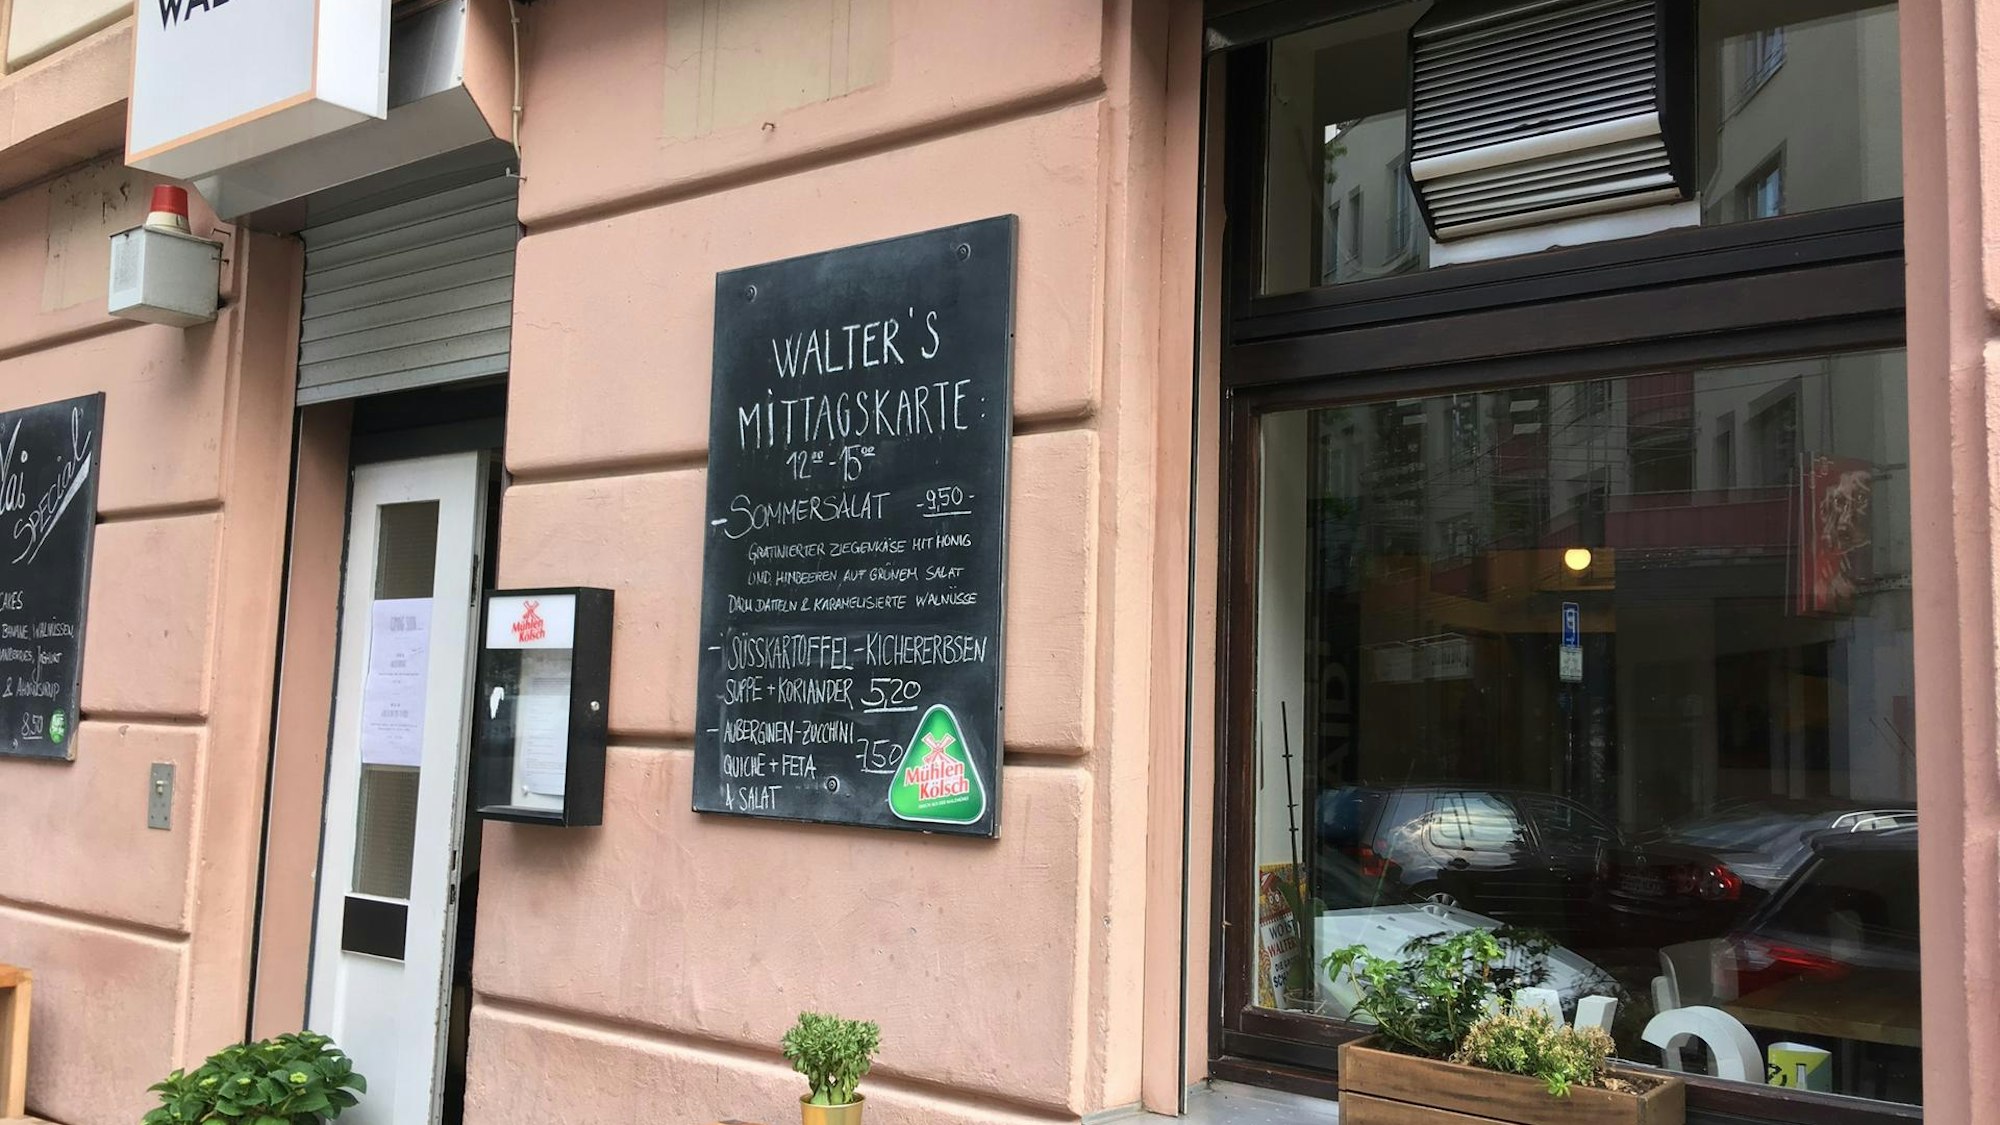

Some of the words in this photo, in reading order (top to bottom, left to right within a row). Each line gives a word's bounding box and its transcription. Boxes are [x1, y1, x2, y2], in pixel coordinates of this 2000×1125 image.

[772, 307, 940, 378] WALTER'S
[748, 542, 825, 565] GRATINIERTER
[829, 537, 906, 557] ZIEGENKÄSE
[936, 533, 972, 549] HONIG
[748, 570, 771, 586] UND
[843, 568, 867, 581] AUF
[869, 562, 918, 581] GRÜNEM
[925, 565, 965, 580] SALAT
[755, 598, 797, 613] DATTELN
[800, 597, 811, 611] &
[813, 595, 906, 612] KARAMELISIERTE
[915, 585, 978, 607] WALNÜSSE
[724, 676, 763, 705] SUPPE
[778, 677, 853, 710] KORIANDER
[723, 753, 766, 778] QUICHE
[782, 753, 817, 779] FETA
[905, 761, 963, 784] Mühlen
[739, 785, 782, 811] SALAT
[920, 776, 968, 799] Kölsch
